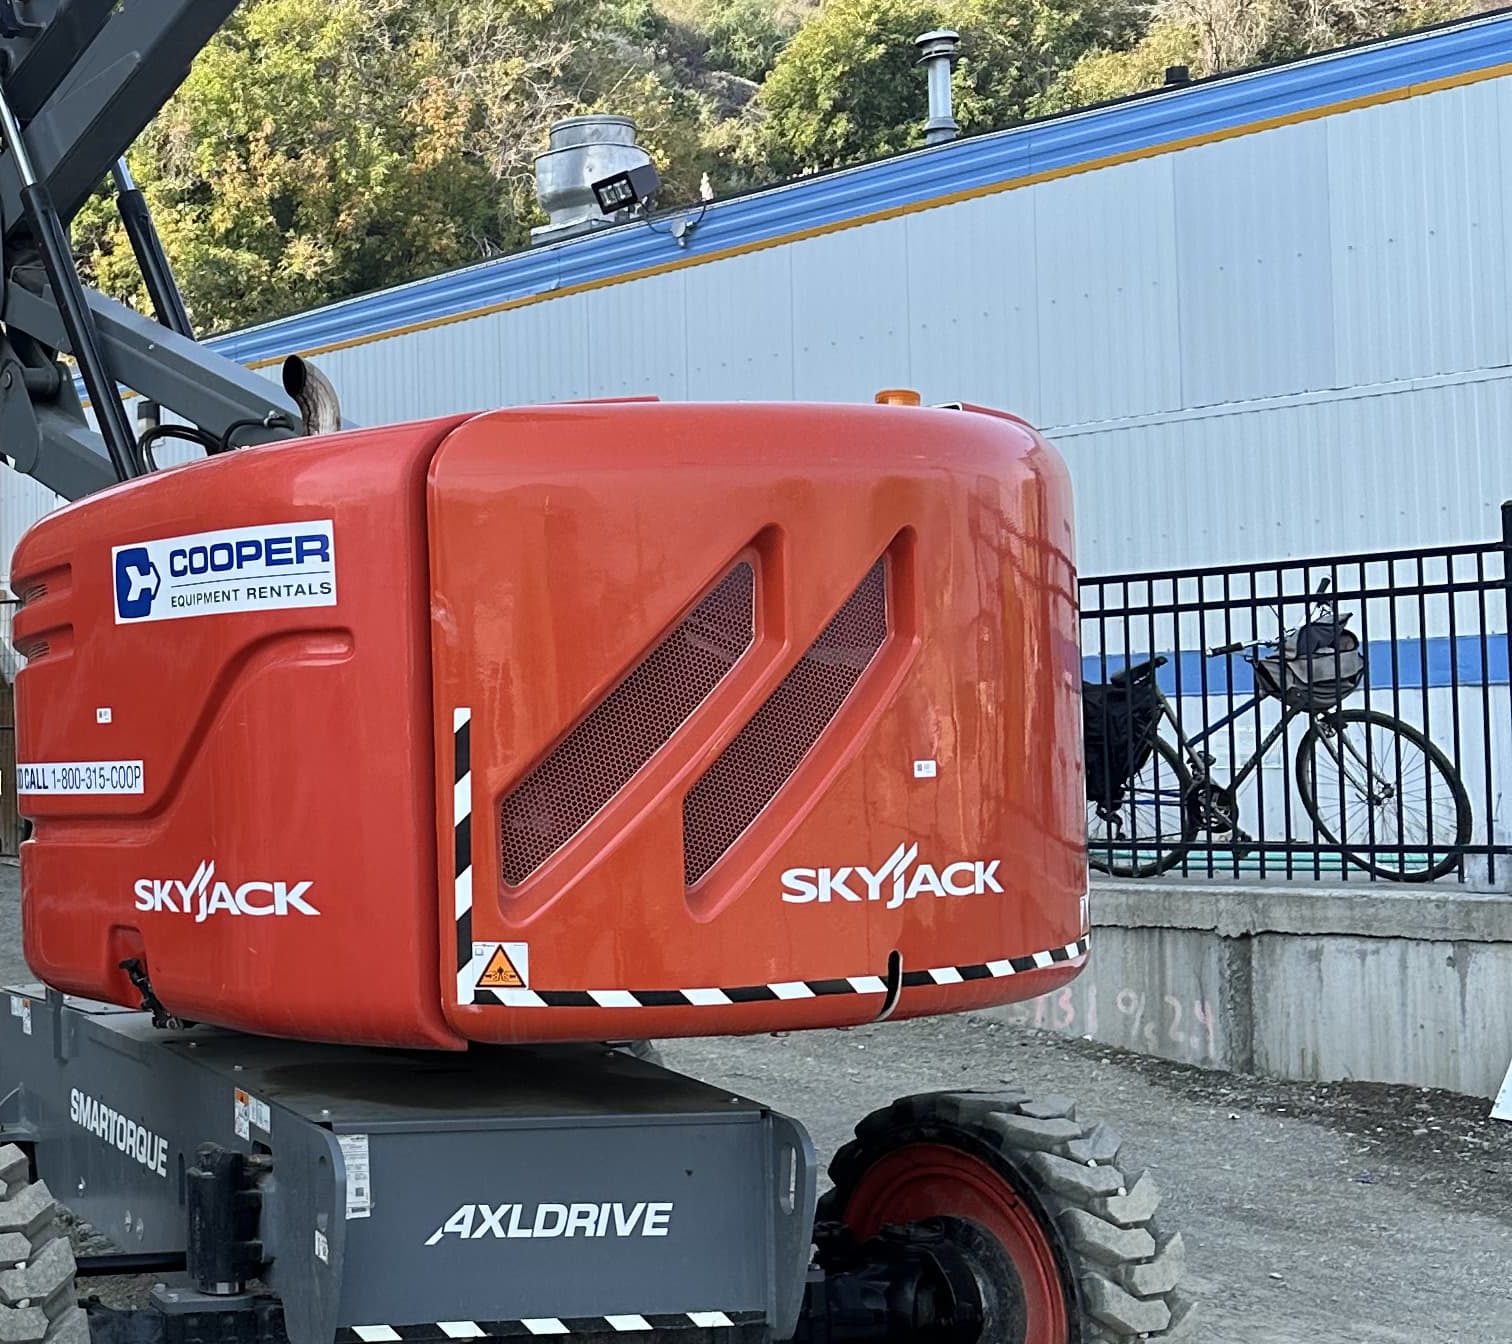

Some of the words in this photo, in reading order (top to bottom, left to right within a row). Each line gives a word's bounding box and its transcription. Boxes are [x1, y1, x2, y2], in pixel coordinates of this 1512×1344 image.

[169, 533, 330, 578] COOPER
[170, 588, 239, 608] EQUIPMENT
[246, 581, 333, 600] RENTALS
[24, 767, 49, 790] CALL
[52, 765, 142, 790] 1-800-315-COOP
[134, 859, 321, 923] SKYJACK
[780, 841, 1005, 910] SKYJACK
[424, 1202, 674, 1246] AXLDRIVE
